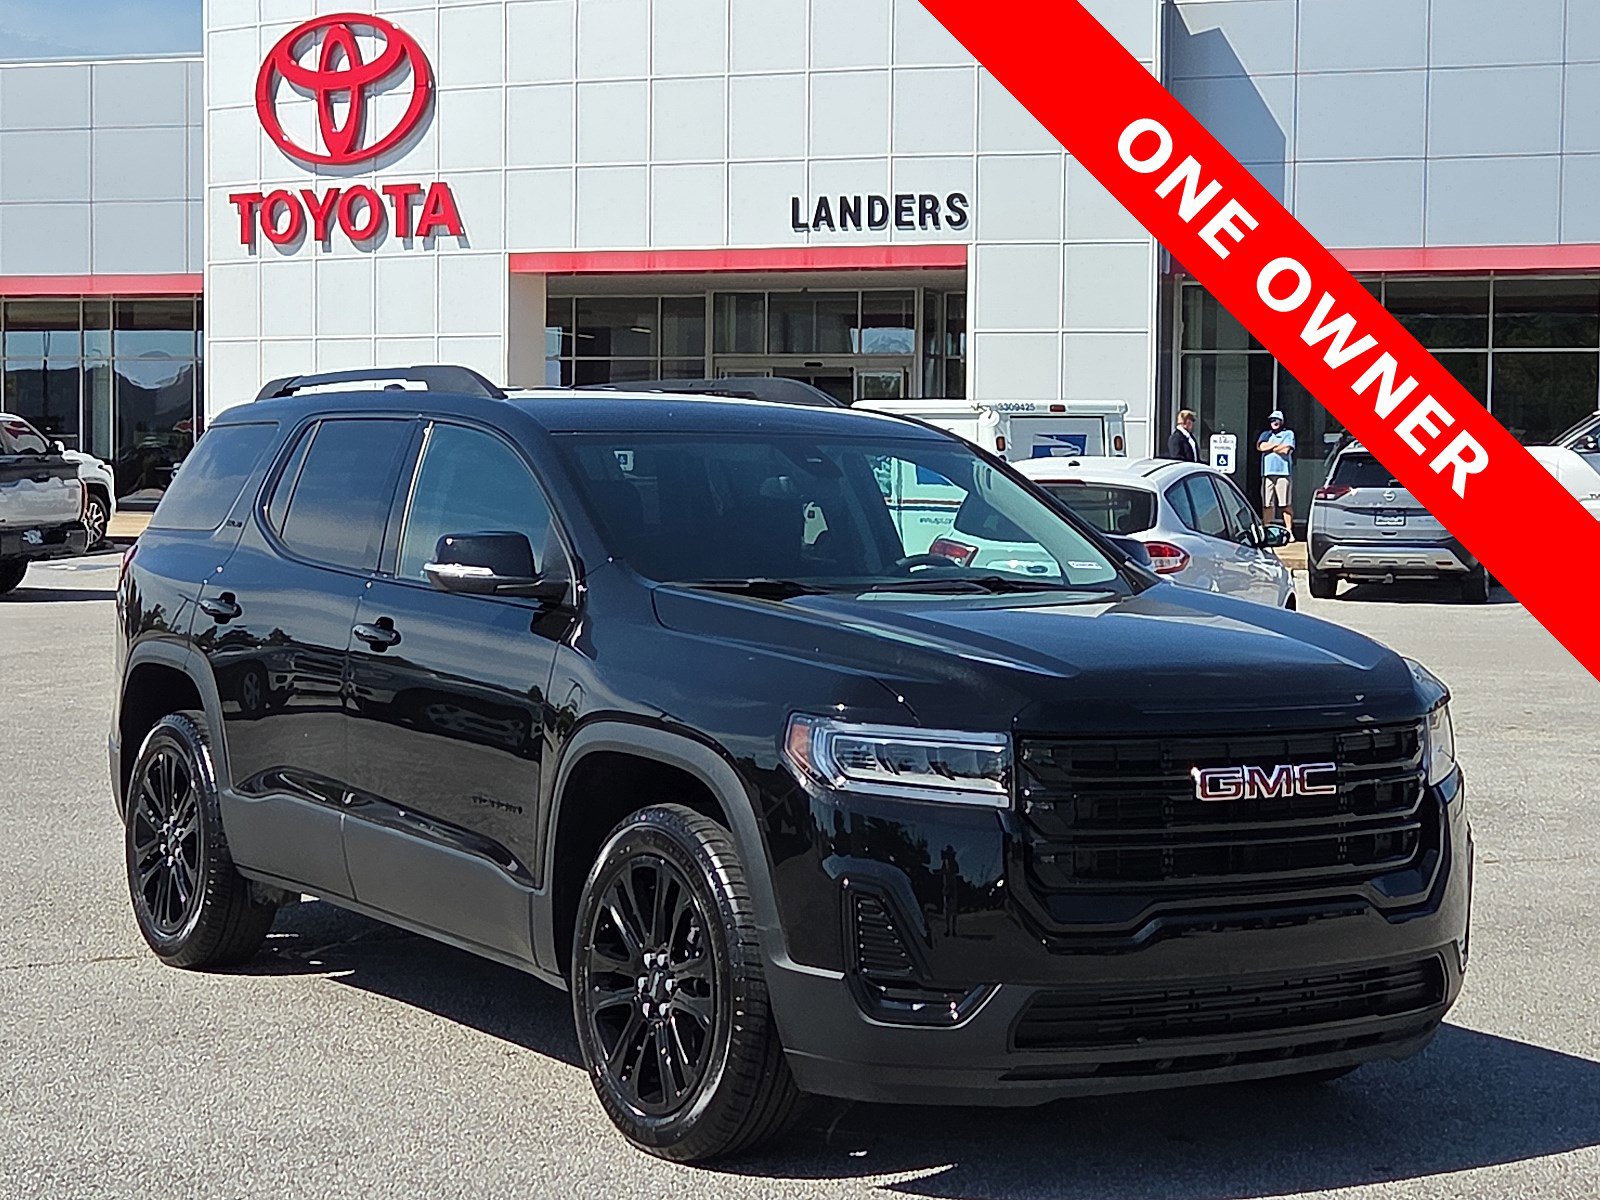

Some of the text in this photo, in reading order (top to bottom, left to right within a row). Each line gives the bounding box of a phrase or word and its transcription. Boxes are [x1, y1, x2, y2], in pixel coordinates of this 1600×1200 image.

[229, 182, 463, 245] TOYOTA
[791, 193, 969, 230] LANDERS
[1193, 762, 1337, 801] GMC
